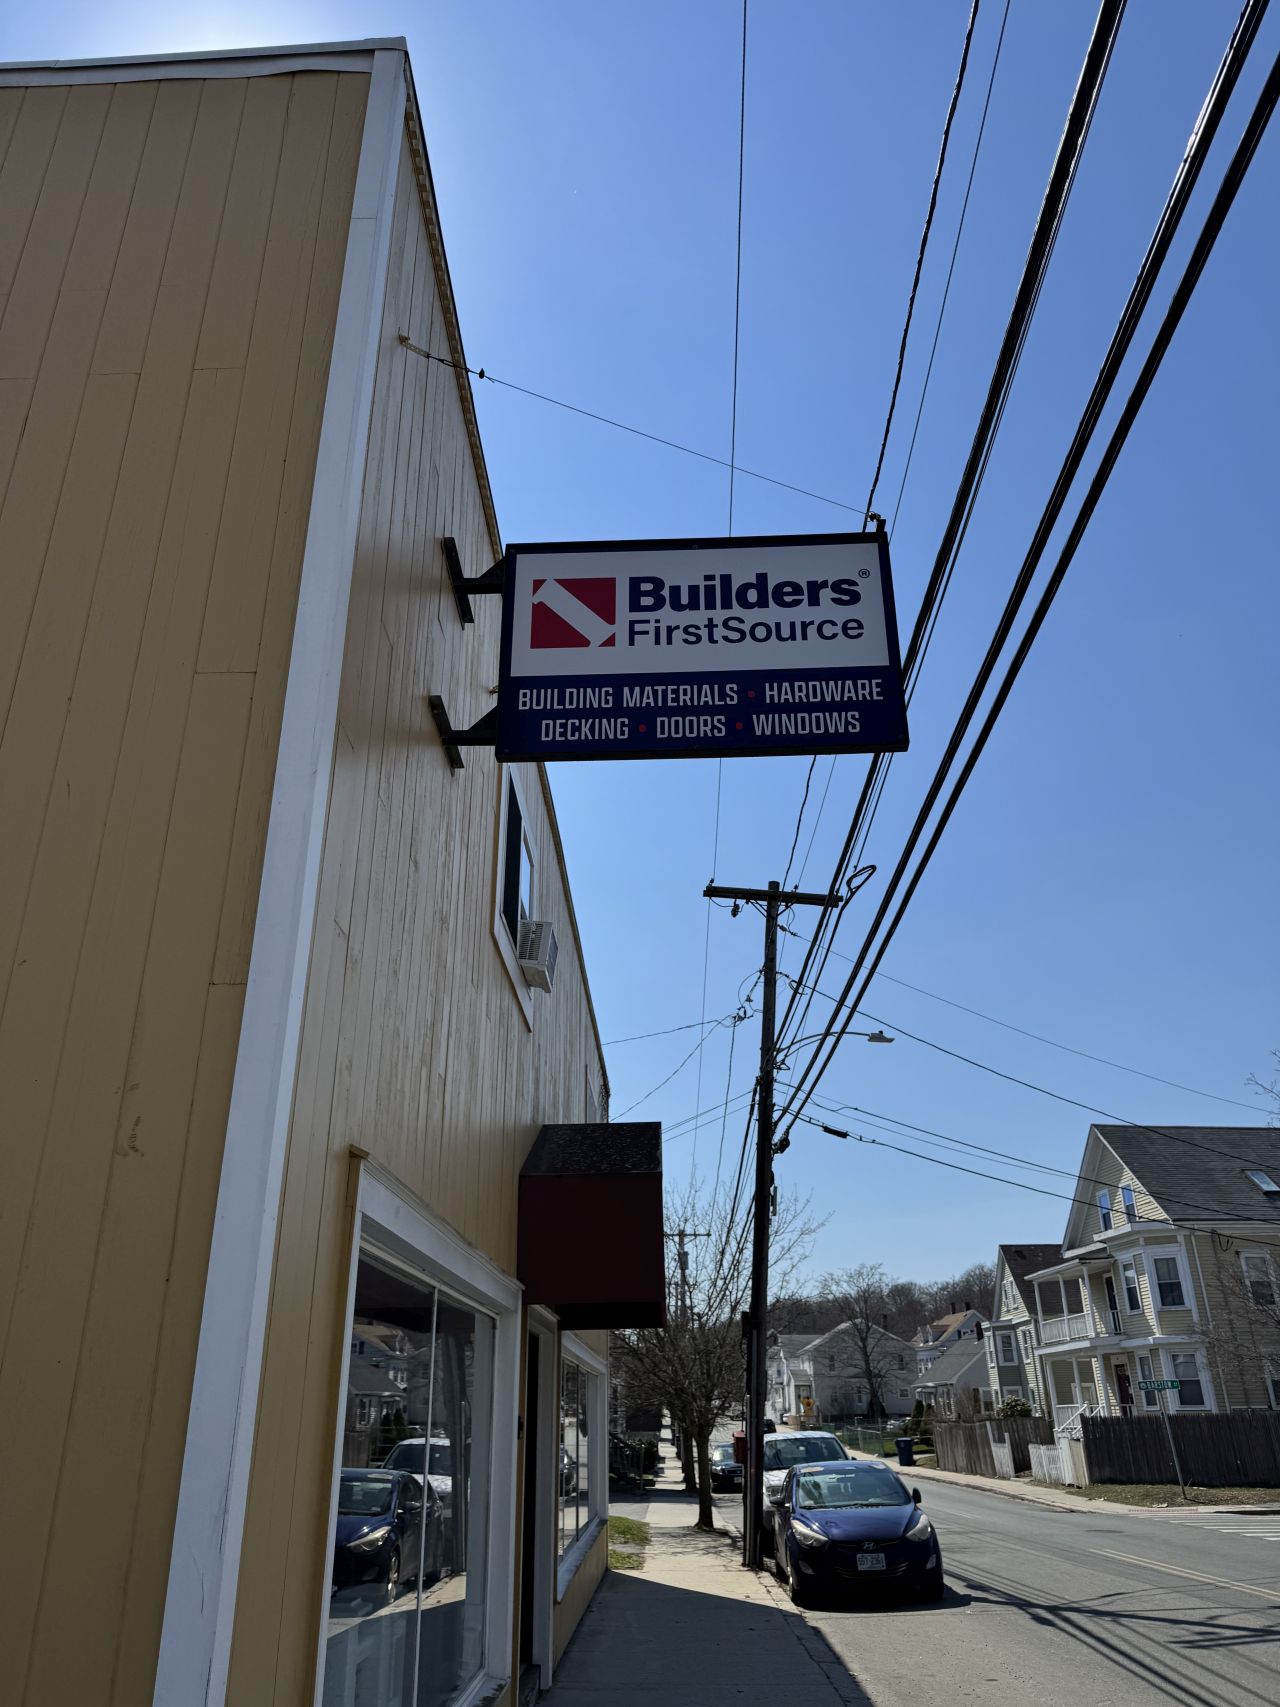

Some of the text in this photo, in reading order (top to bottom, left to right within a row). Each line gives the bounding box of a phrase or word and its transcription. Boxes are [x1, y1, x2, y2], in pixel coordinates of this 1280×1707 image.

[629, 617, 864, 646] FirstSource
[519, 680, 883, 710] BUILDING MATERIALS HARDWARE
[542, 712, 861, 741] DECKING DOORS WINDOWS
